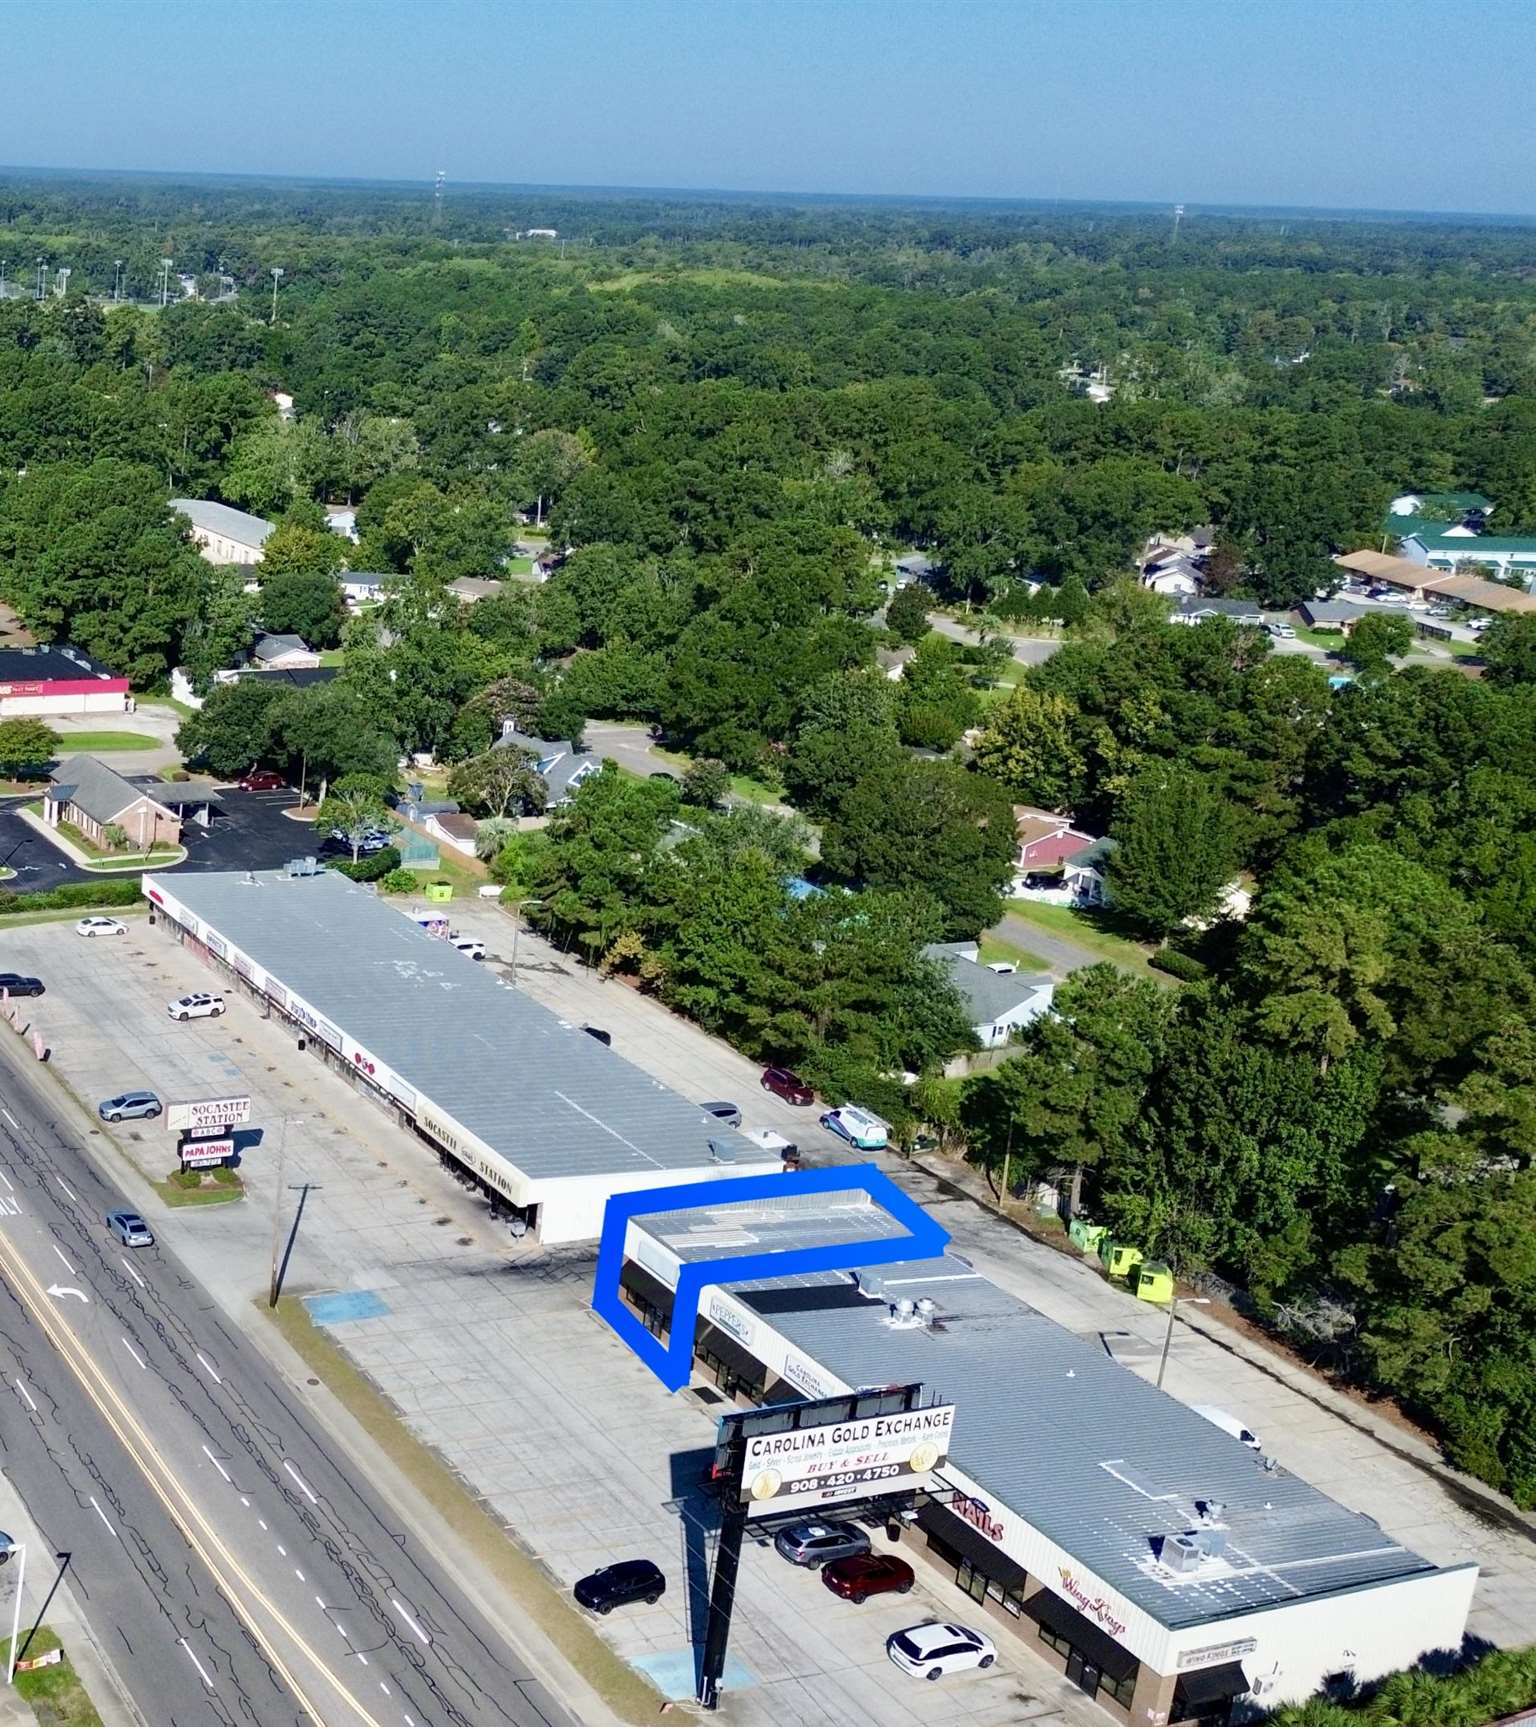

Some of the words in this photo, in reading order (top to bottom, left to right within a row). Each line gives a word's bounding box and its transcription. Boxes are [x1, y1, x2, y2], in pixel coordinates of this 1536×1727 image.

[191, 1101, 250, 1116] SOCASTEE
[196, 1112, 243, 1126] STATION
[185, 1147, 205, 1157] PAPA
[479, 1160, 513, 1195] STATION
[752, 1432, 825, 1457] CAROLINA
[832, 1426, 870, 1444] GOLD
[875, 1411, 951, 1437] EXCHANGE
[807, 1461, 834, 1473] BUY
[855, 1452, 889, 1465] SELL
[952, 1491, 1004, 1541] NAILS
[1062, 1577, 1091, 1611] Wing
[1089, 1598, 1126, 1636] Kings
